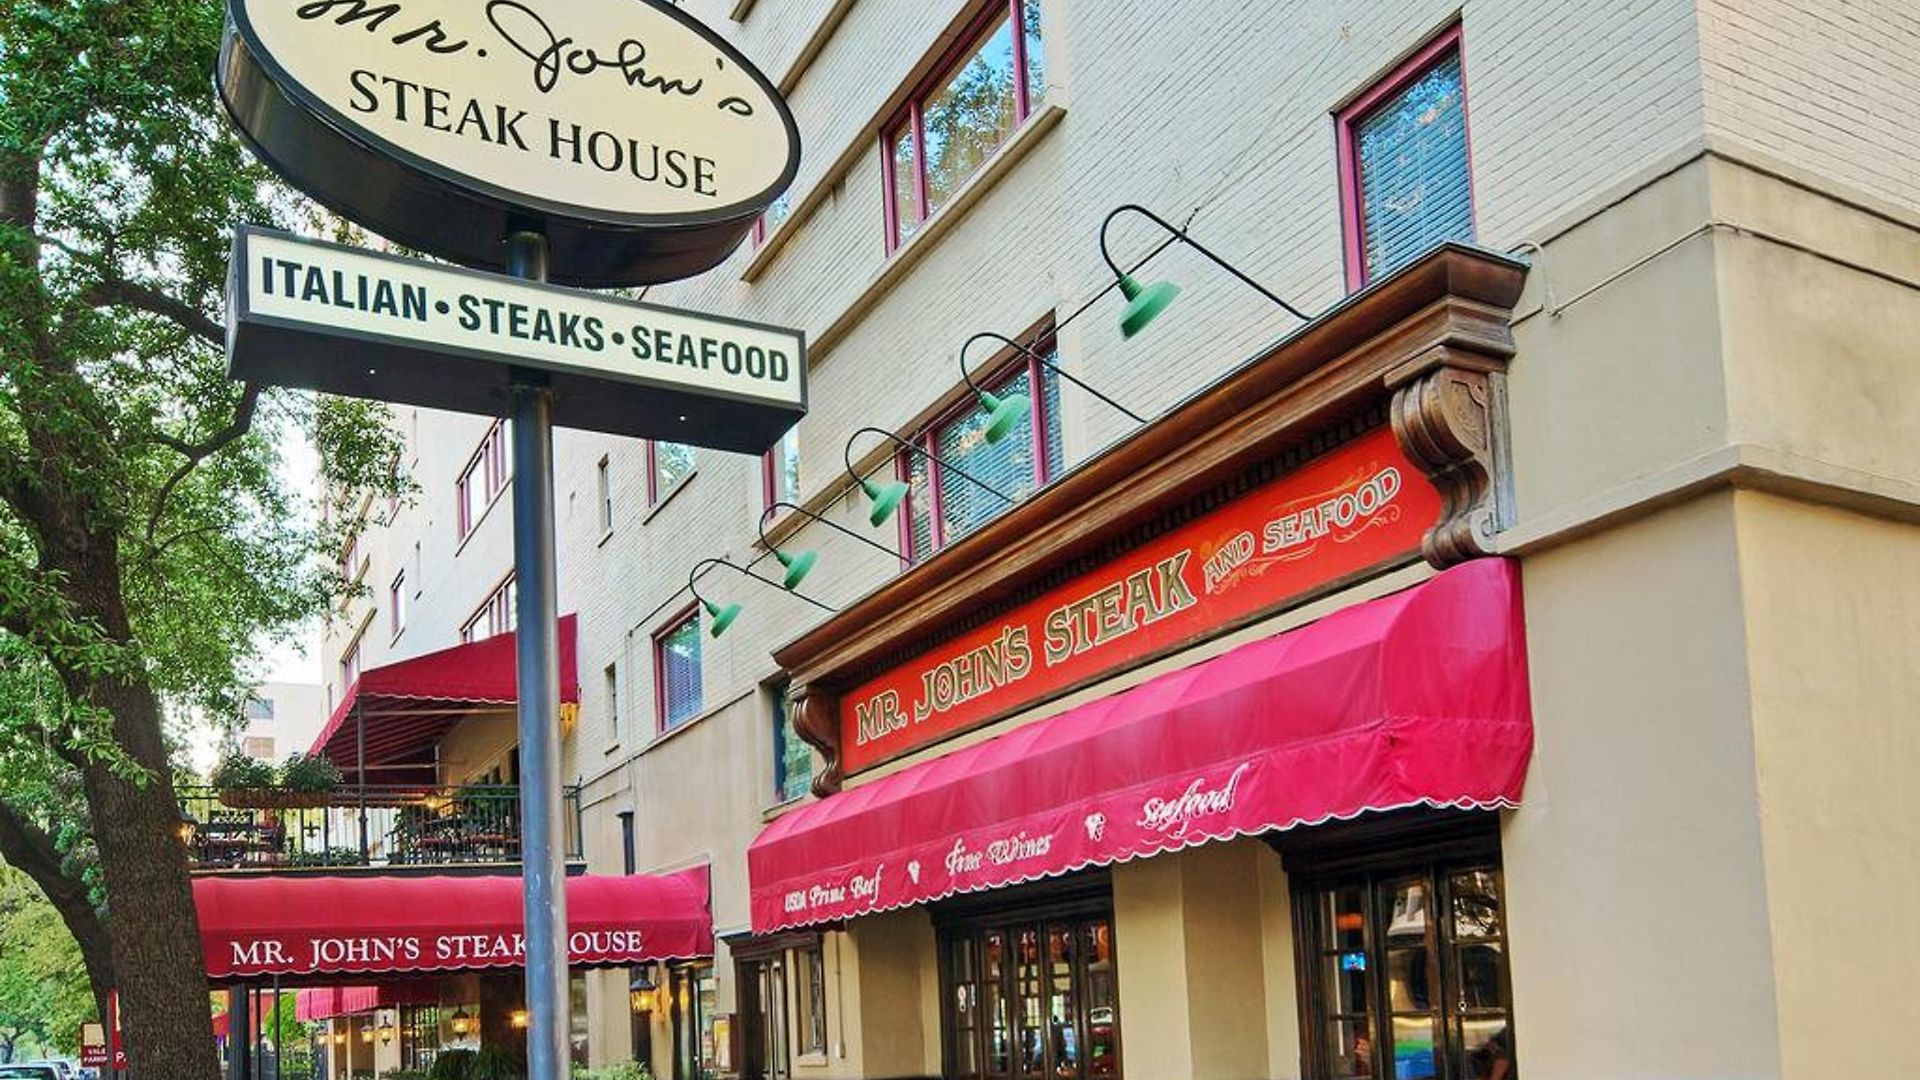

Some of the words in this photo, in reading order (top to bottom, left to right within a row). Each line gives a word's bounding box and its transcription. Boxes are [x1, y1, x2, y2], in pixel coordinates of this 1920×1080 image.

[296, 0, 487, 57] Mr.
[486, 0, 754, 117] John's
[349, 70, 529, 152] STEAK
[548, 118, 717, 197] HOUSE
[262, 256, 428, 321] ITALIAN
[458, 294, 604, 352] STEAKS
[631, 325, 790, 383] SEAFOOD
[856, 691, 907, 746] MR.
[914, 622, 1034, 722] JOHN'S
[1044, 549, 1197, 668] STEAK
[1202, 532, 1255, 592] AND
[1262, 466, 1401, 550] SEAFOOD
[809, 881, 846, 908] Prime
[850, 863, 884, 905] Beef
[945, 836, 983, 876] Fine
[987, 830, 1054, 865] Wines
[1136, 762, 1249, 839] Seafood
[231, 940, 295, 966] MR.
[309, 936, 420, 968] JOHN'S
[436, 933, 526, 959] STEAK
[568, 930, 643, 955] OUSE
